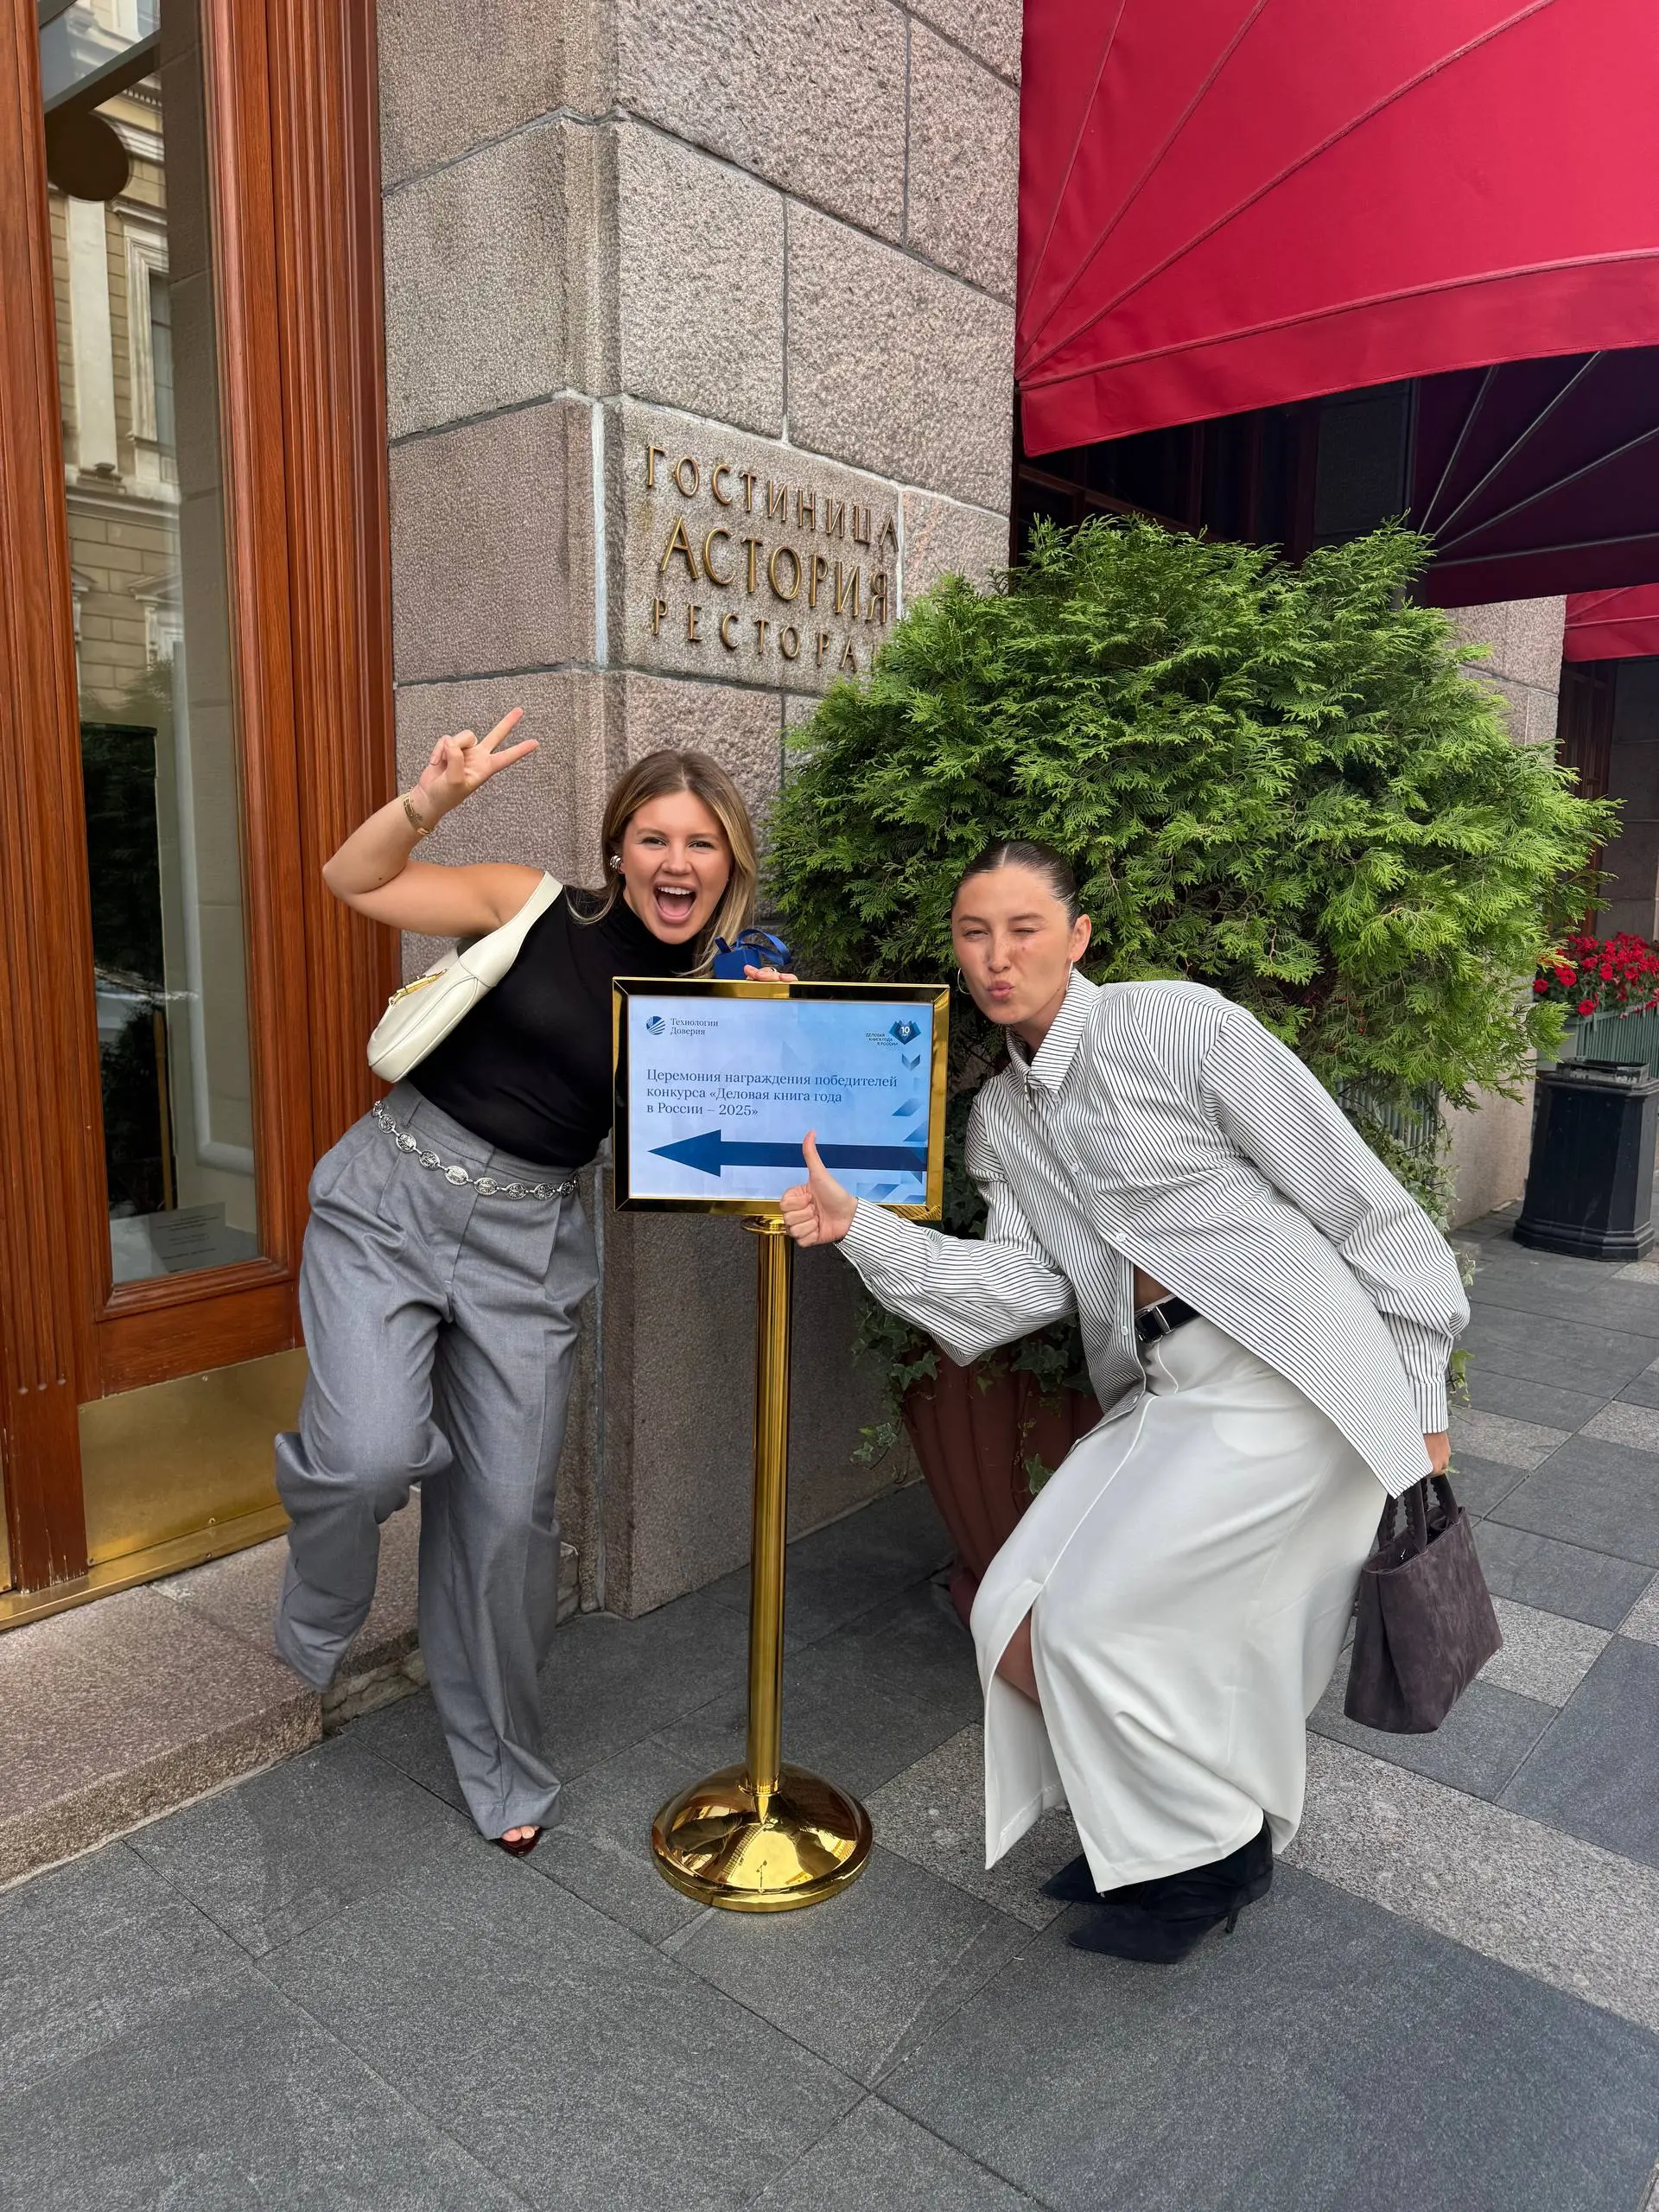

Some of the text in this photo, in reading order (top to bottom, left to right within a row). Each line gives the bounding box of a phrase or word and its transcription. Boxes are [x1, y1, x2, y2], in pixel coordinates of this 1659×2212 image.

[648, 445, 899, 551] ГОСТИНИЦА
[659, 516, 888, 624] АСТОРИЯ
[670, 1018, 718, 1027] Технологии
[670, 1027, 705, 1036] Доверия
[646, 1069, 898, 1088] Церемония награждения победителей
[646, 1088, 842, 1103] конкурса «Деловая книга года
[646, 1104, 654, 1113] в
[657, 1103, 703, 1114] России
[718, 1103, 759, 1116] 2025»
